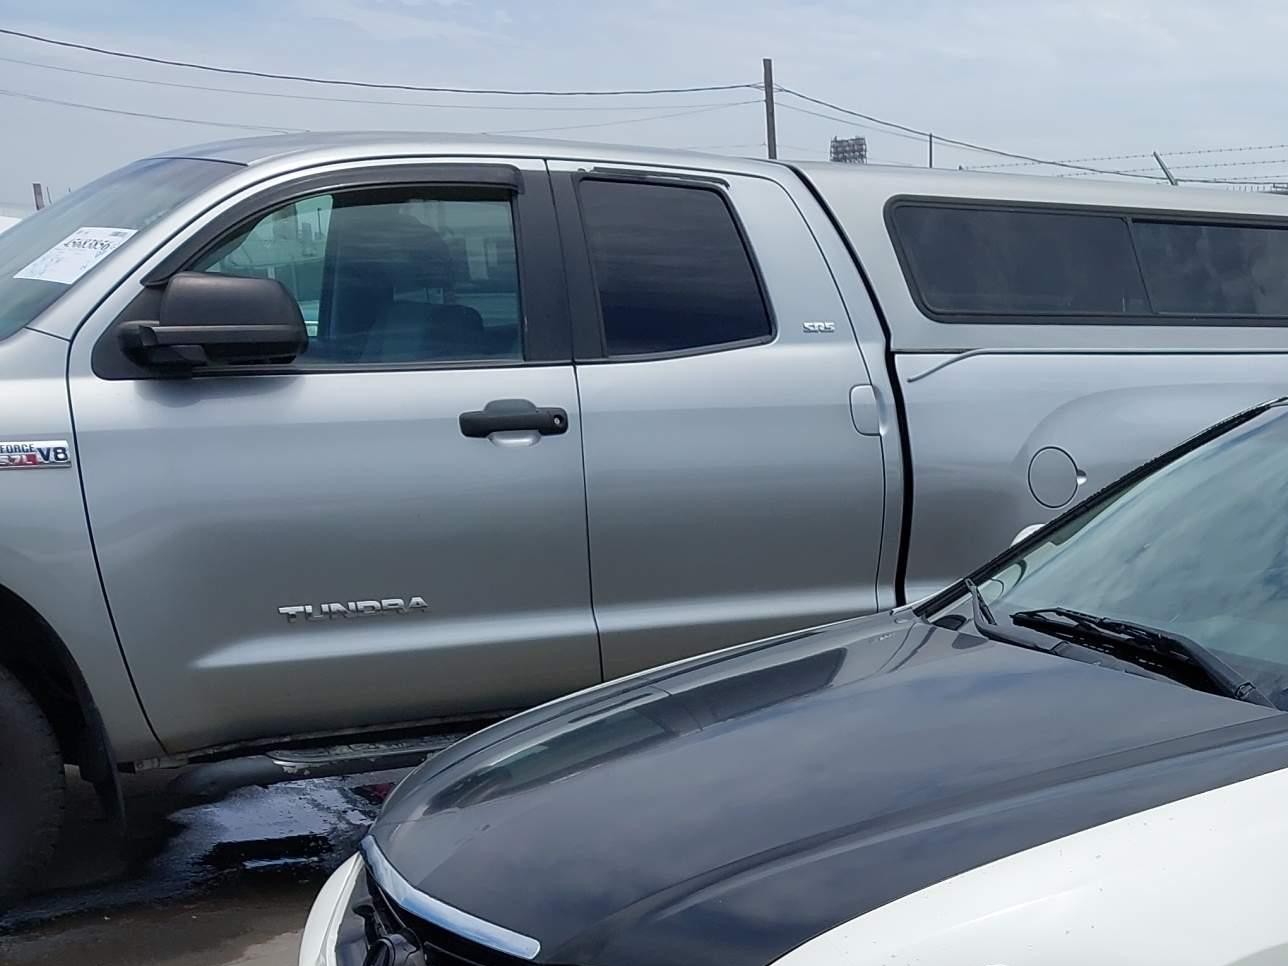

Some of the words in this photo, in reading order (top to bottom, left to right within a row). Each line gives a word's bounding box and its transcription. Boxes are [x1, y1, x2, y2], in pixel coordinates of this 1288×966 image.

[802, 321, 836, 333] SR5
[37, 447, 69, 461] V8
[278, 596, 429, 623] TUNDRA
